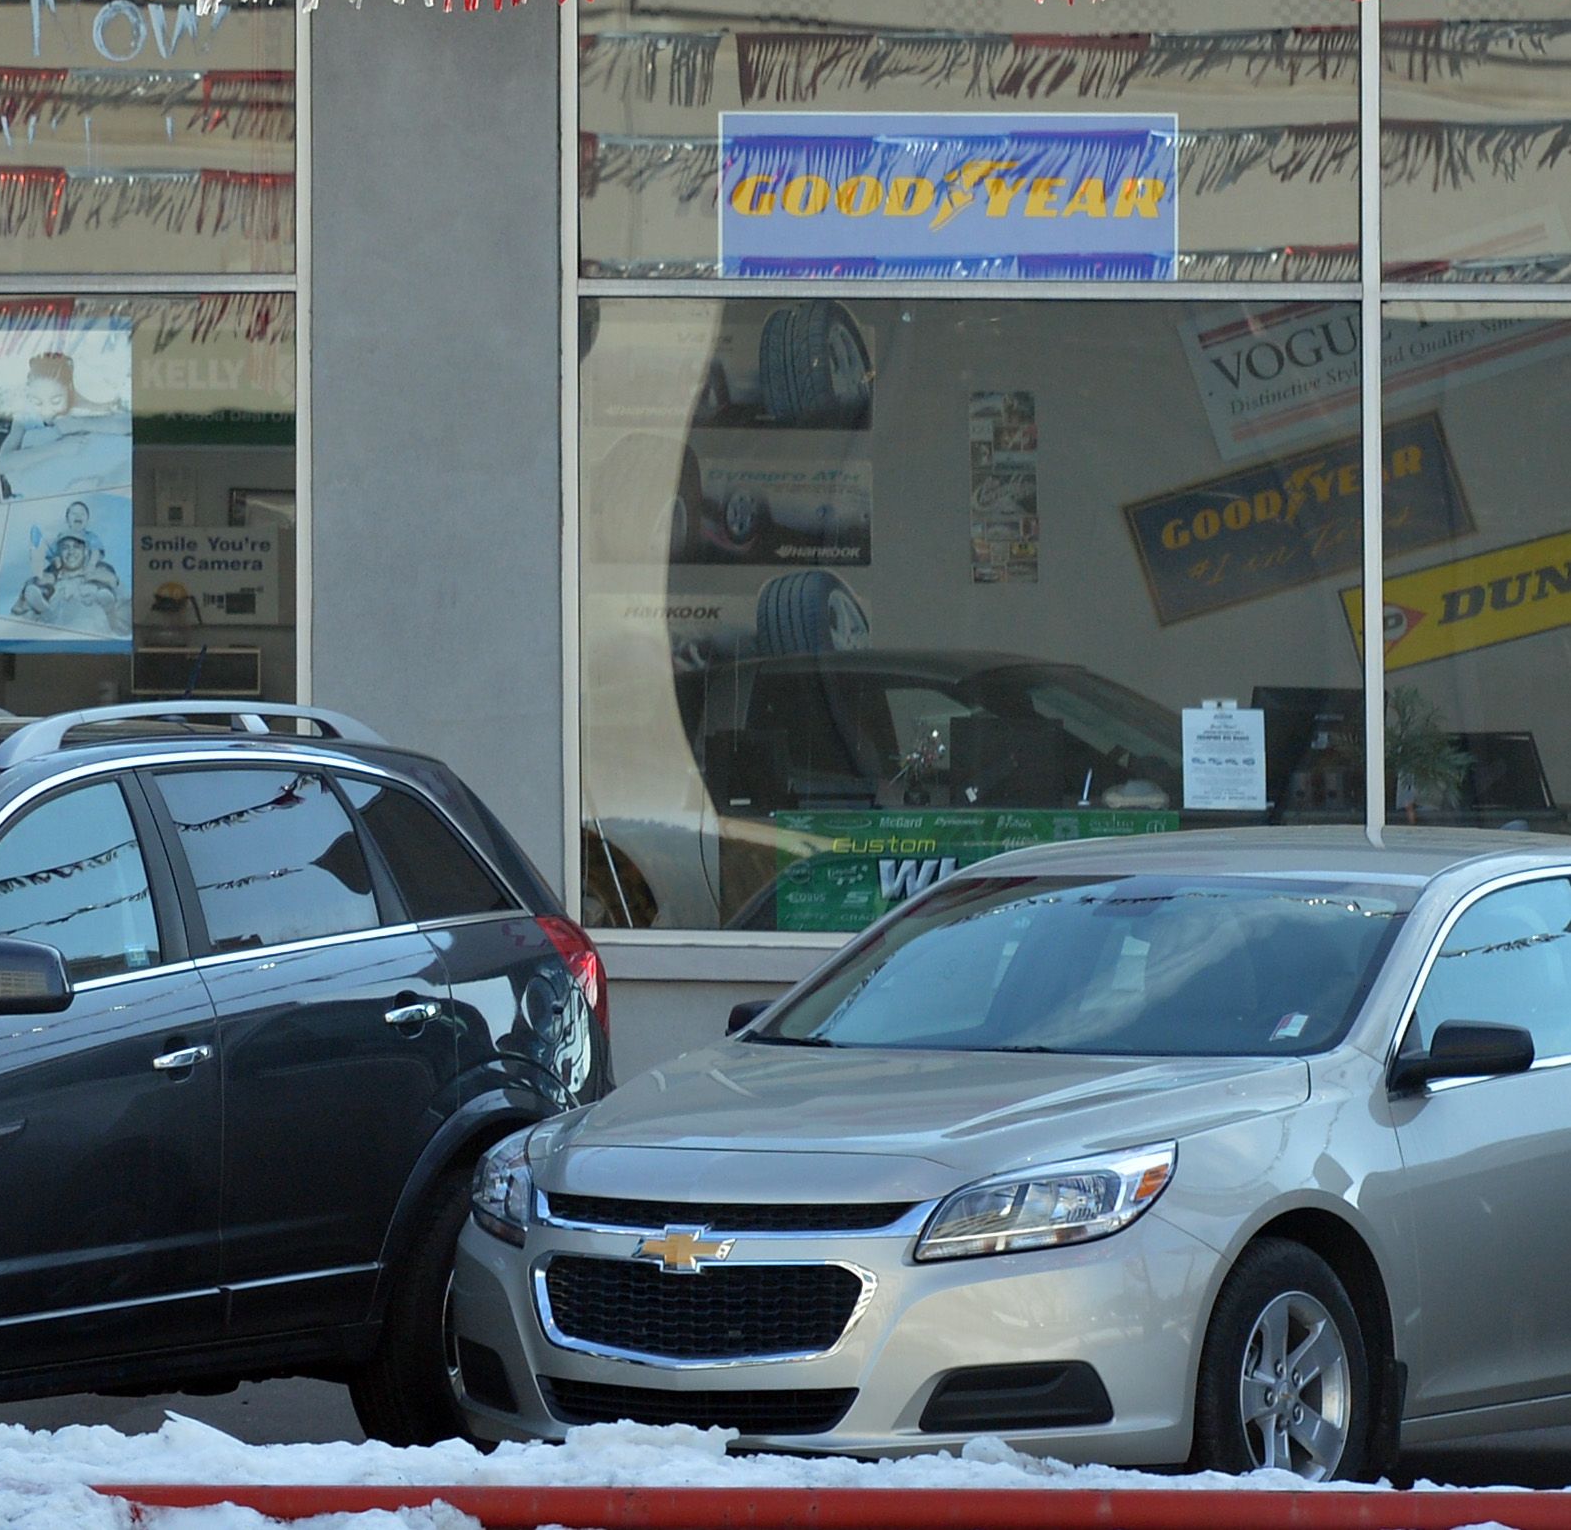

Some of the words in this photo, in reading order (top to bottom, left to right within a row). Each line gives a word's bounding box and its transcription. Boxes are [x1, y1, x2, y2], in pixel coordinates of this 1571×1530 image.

[732, 172, 1165, 220] GOODYEAR
[1210, 308, 1391, 391] VOGU
[1327, 359, 1362, 387] Styl
[1410, 327, 1477, 360] Quality
[140, 358, 245, 390] KELLY
[1161, 443, 1424, 551] GOODYER
[140, 535, 198, 552] Smile
[207, 536, 271, 552] You're
[148, 557, 174, 571] on
[181, 555, 264, 571] Camera
